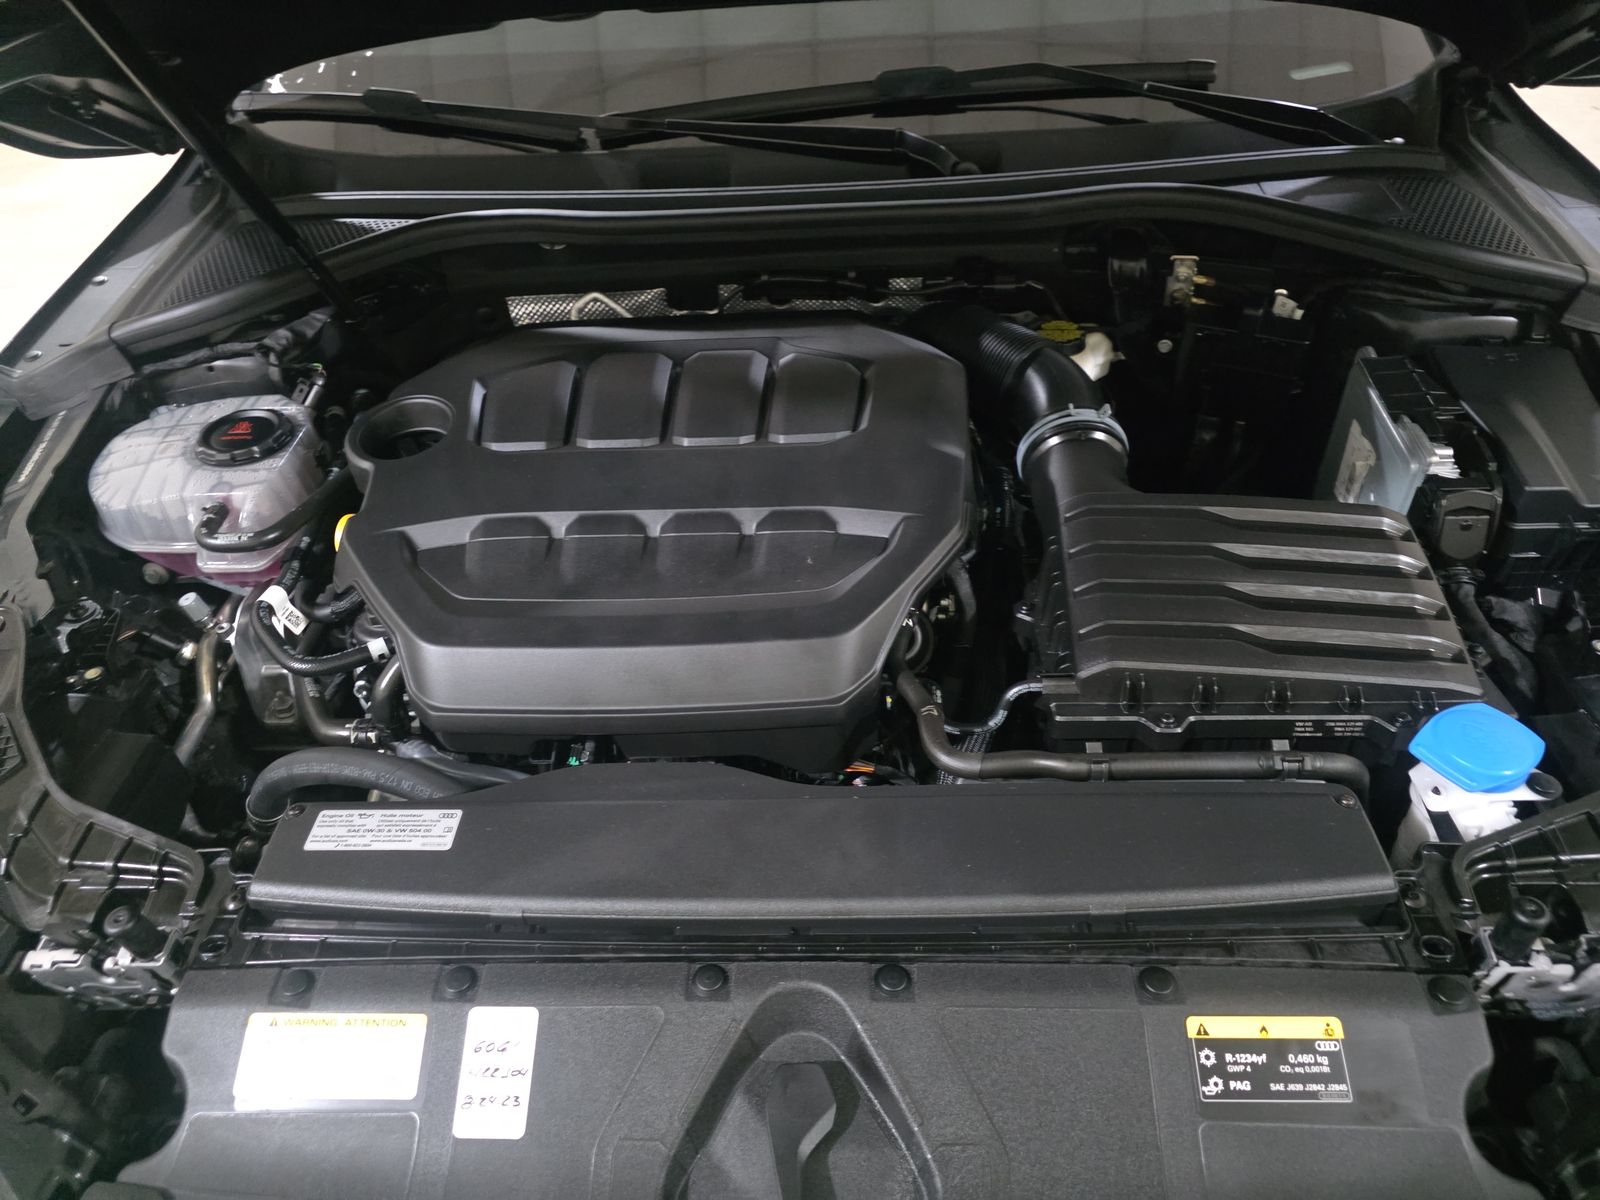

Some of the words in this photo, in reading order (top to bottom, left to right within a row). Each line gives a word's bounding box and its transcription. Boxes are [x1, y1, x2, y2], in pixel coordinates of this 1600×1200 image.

[284, 1018, 336, 1027] WARNING
[345, 1018, 407, 1027] ATTENTION
[1225, 1053, 1267, 1065] R-1234yf
[1288, 1054, 1314, 1064] 0,460
[1316, 1054, 1328, 1065] kg
[1229, 1081, 1251, 1091] PAG
